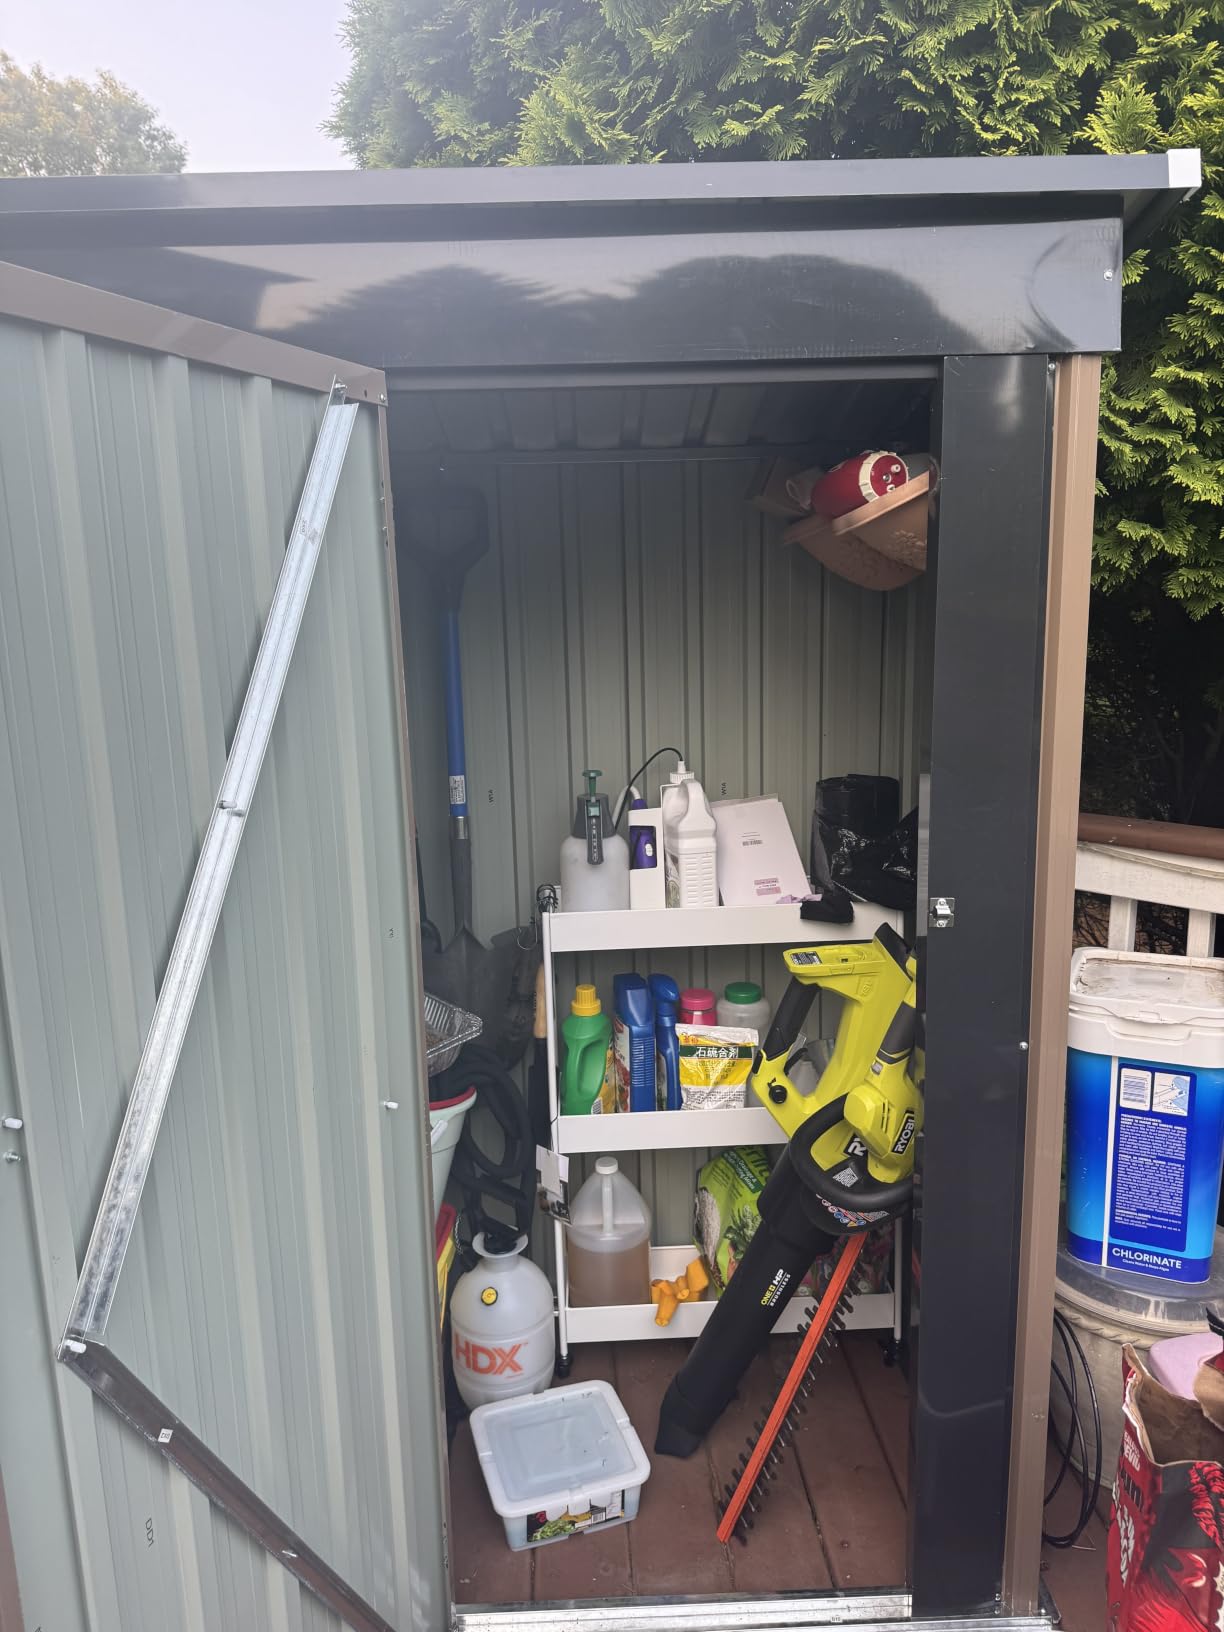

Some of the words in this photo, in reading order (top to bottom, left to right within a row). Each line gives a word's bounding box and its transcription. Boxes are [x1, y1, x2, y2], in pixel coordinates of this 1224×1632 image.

[894, 1118, 915, 1152] RYOBI
[1112, 1248, 1182, 1269] CHLORINATE
[772, 1268, 784, 1285] HP
[454, 1332, 523, 1375] HDX
